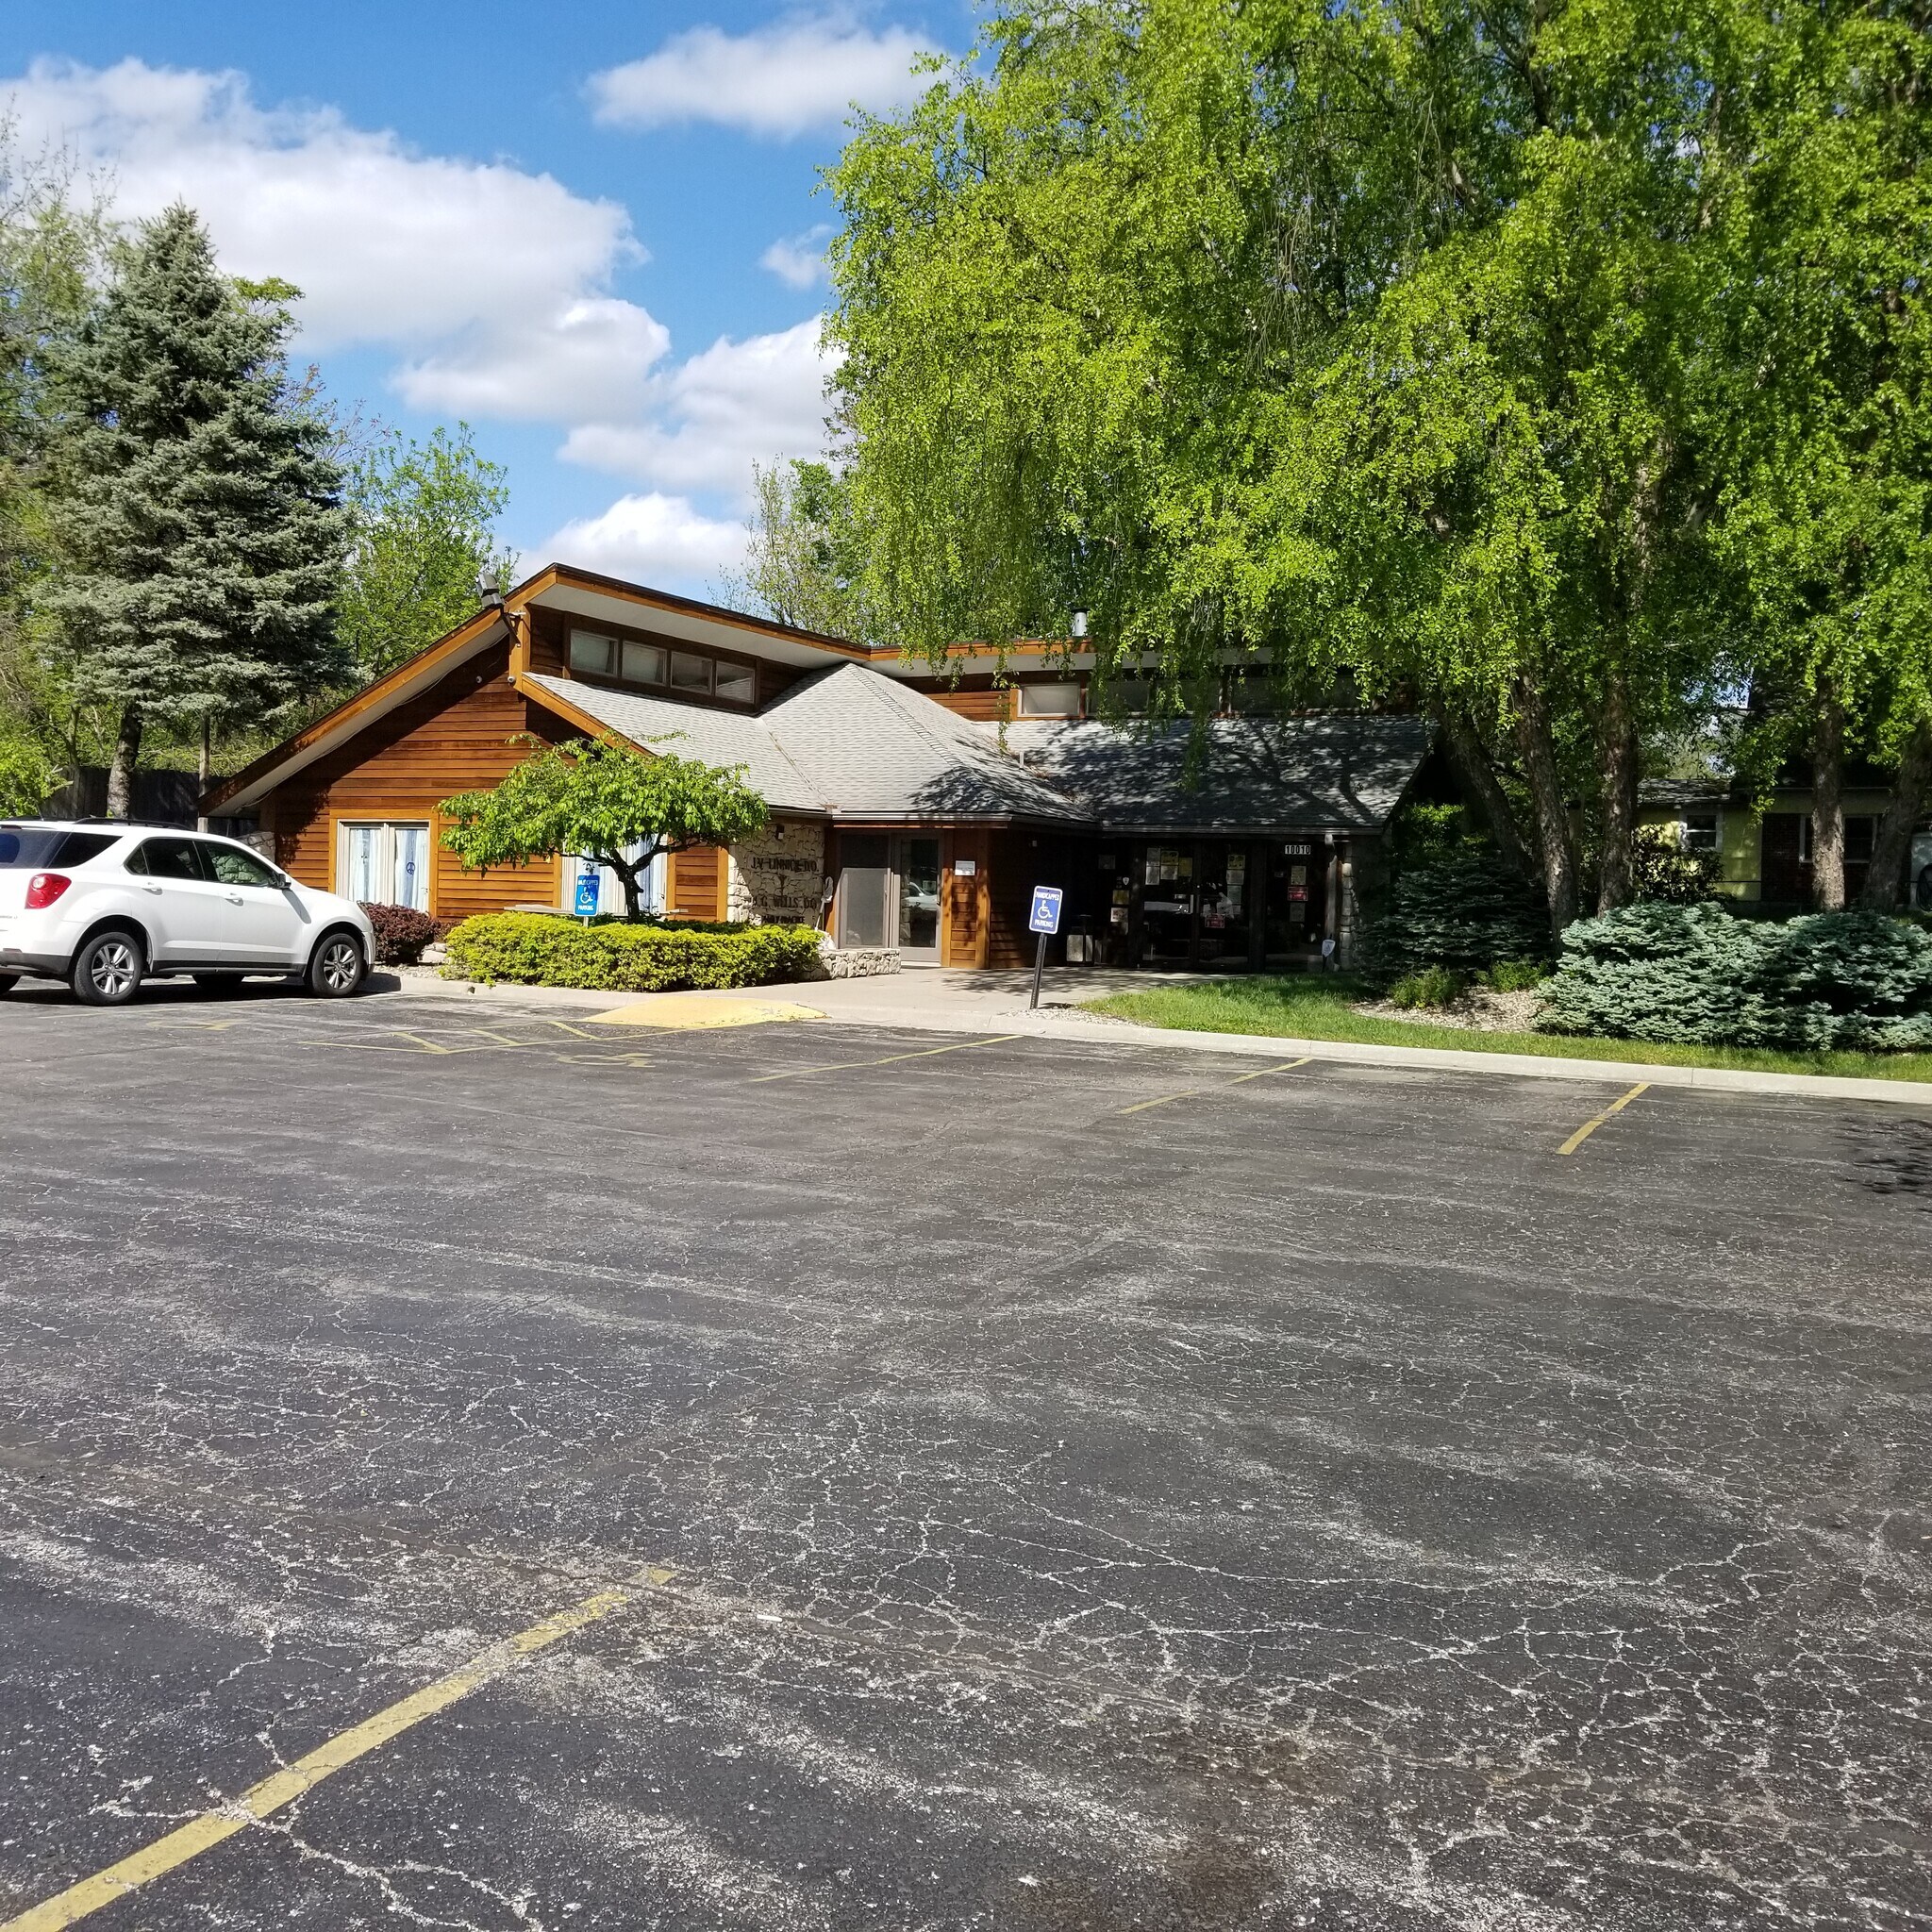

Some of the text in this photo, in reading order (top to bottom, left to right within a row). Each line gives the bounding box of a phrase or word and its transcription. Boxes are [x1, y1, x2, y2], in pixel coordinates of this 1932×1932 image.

[1286, 845, 1310, 855] 10010
[1035, 891, 1060, 901] HANDICAPPED
[1035, 919, 1054, 928] PARKING
